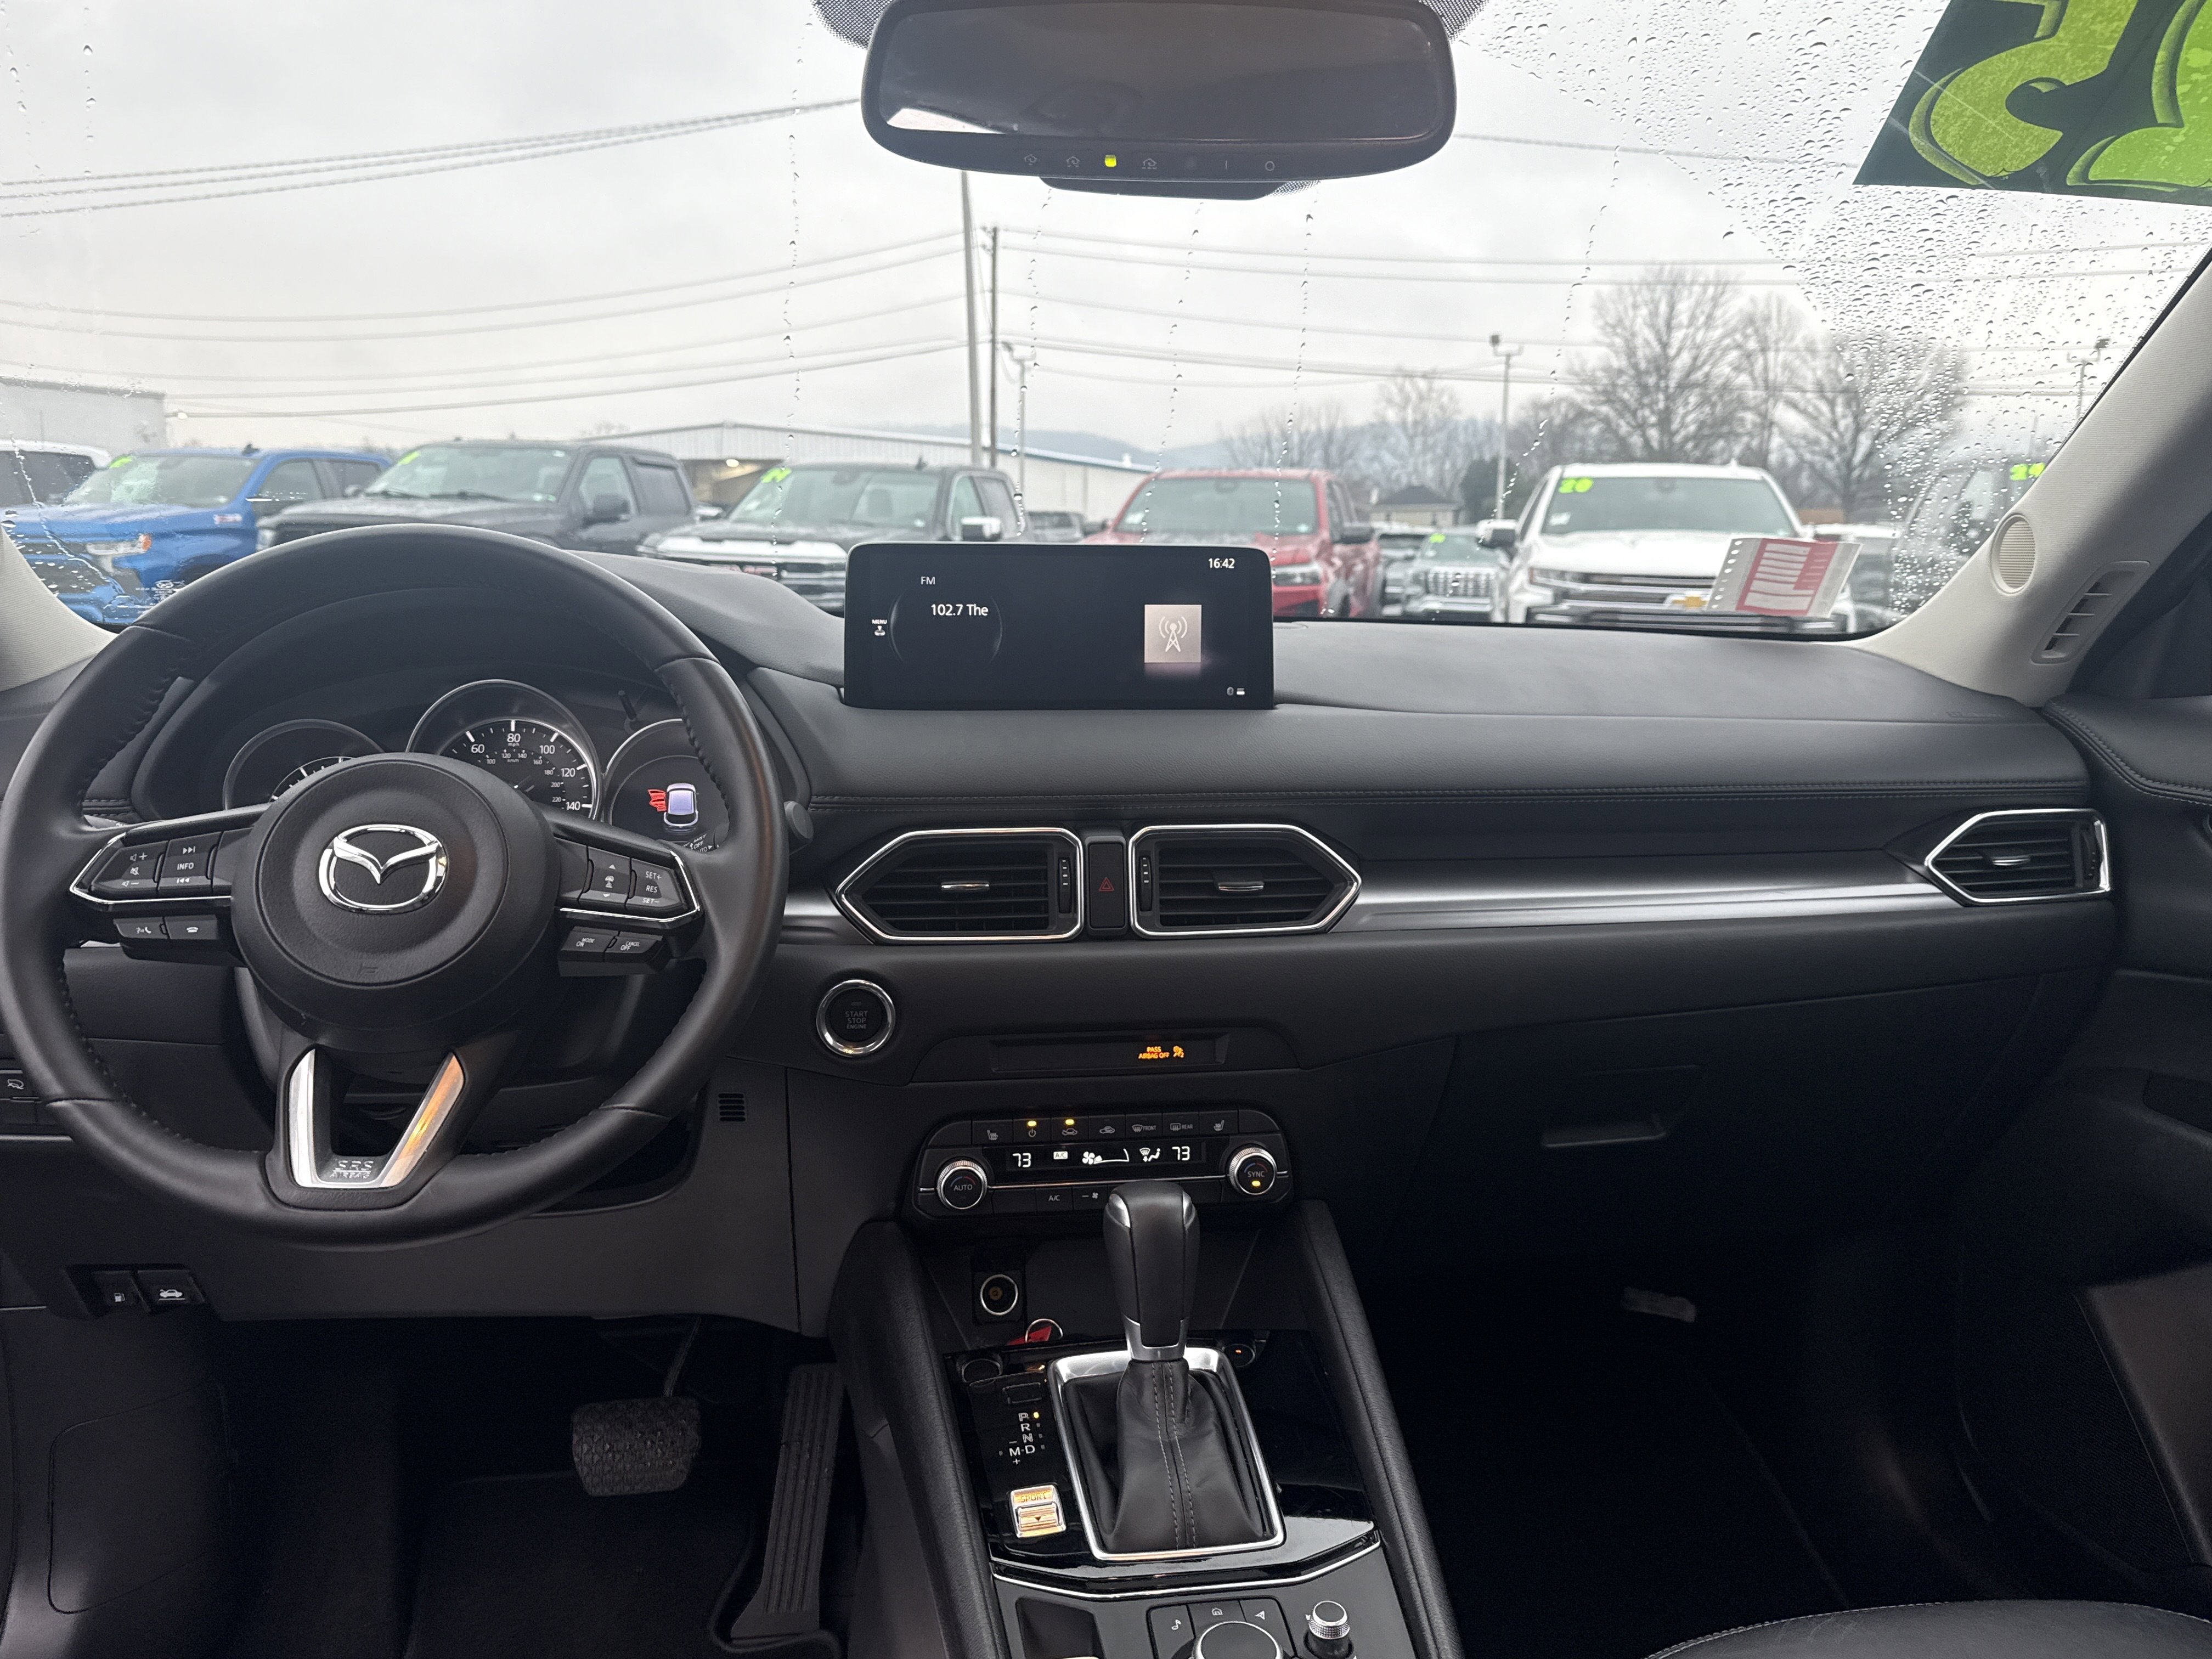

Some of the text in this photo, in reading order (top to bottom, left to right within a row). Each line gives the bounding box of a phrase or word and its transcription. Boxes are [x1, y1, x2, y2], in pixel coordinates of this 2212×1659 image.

[1208, 558, 1235, 569] 16:42
[921, 577, 936, 585] FM
[931, 604, 989, 616] 102.7 The
[507, 733, 521, 742] 80
[471, 744, 485, 753] 60
[539, 744, 555, 754] 100
[561, 768, 575, 777] 120
[566, 802, 580, 811] 140
[177, 862, 194, 871] INFO
[645, 871, 662, 880] SET+
[646, 885, 658, 893] RES
[1172, 1146, 1190, 1160] 73
[1012, 1153, 1031, 1167] 73
[335, 1160, 374, 1170] SRS
[1018, 1413, 1029, 1421] P
[1021, 1424, 1031, 1432] R
[1023, 1434, 1034, 1443] N
[1009, 1444, 1035, 1457] M D
[1021, 1492, 1048, 1502] SPORT
